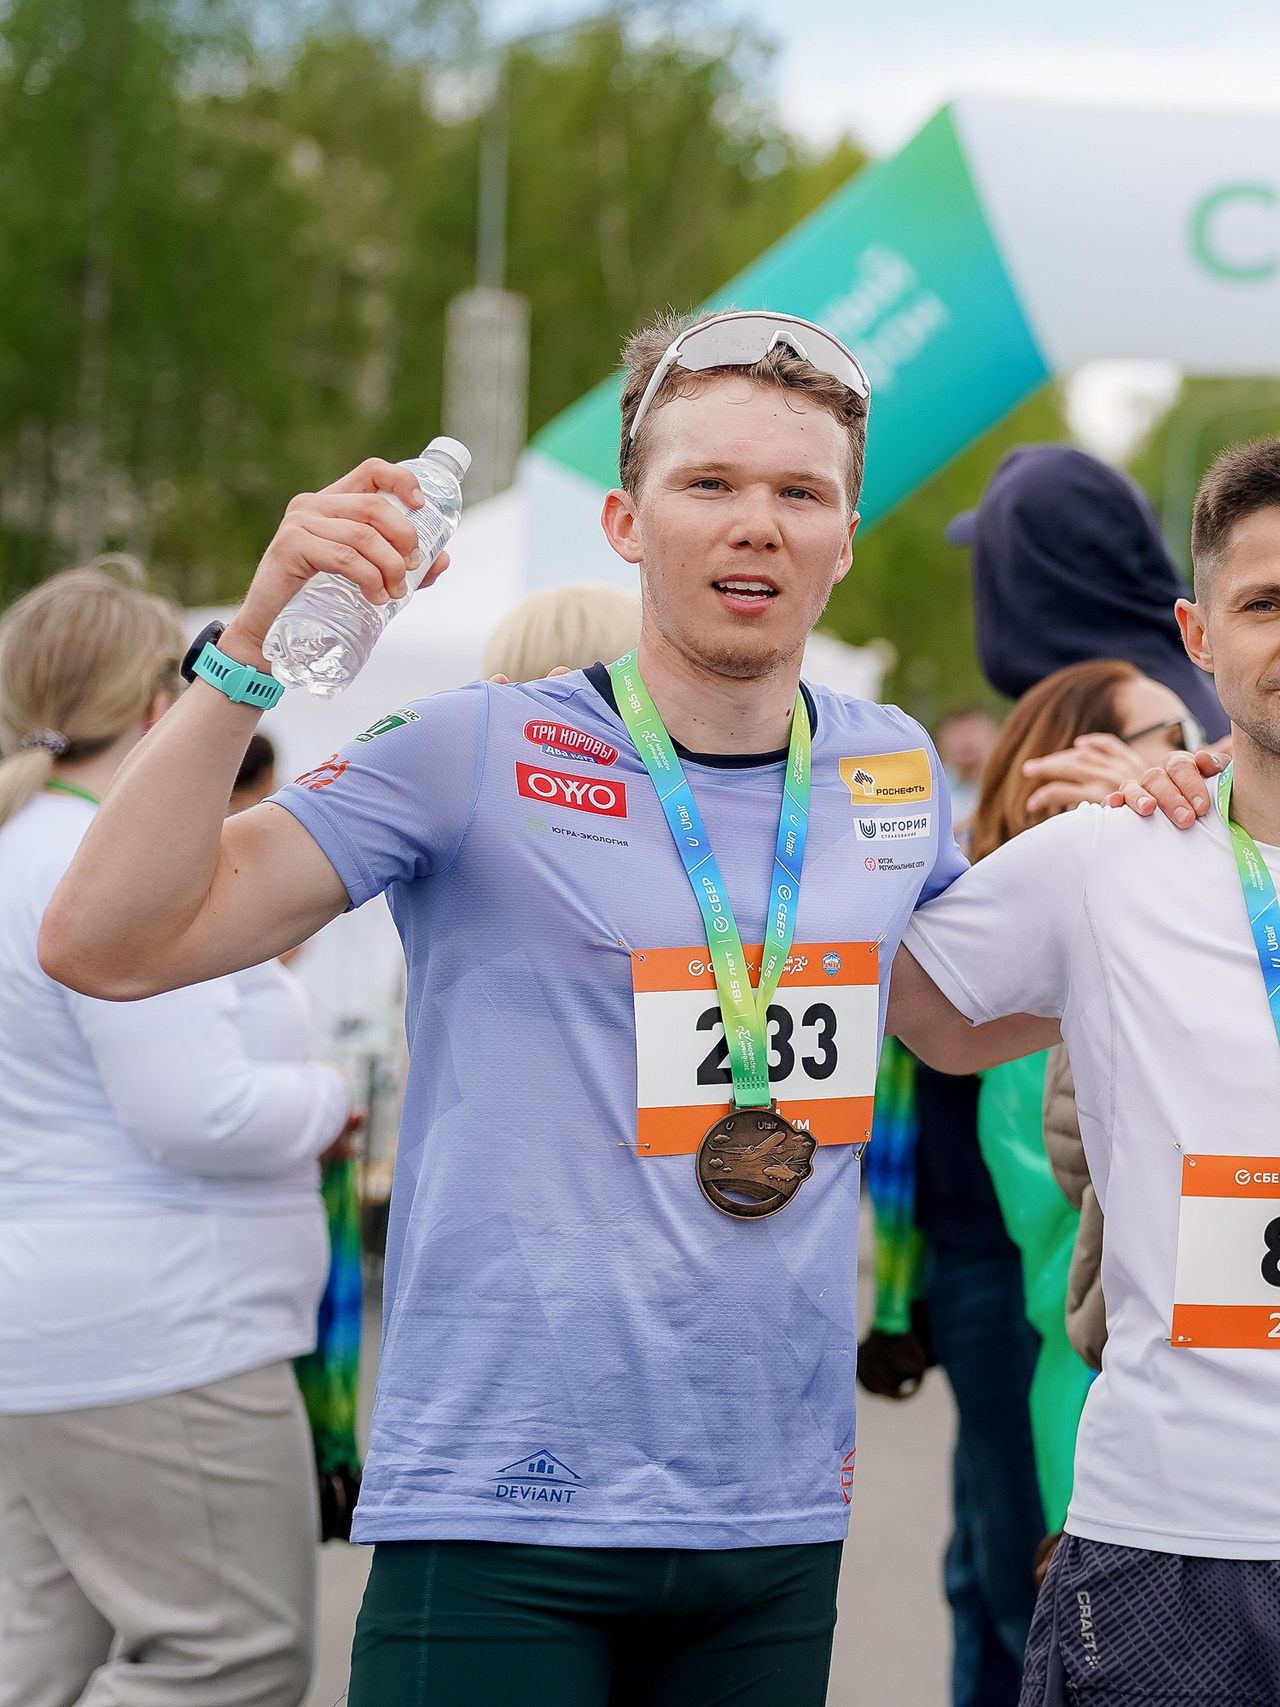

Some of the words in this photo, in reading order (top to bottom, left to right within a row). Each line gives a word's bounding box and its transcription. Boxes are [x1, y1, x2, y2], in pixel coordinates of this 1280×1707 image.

[623, 674, 634, 691] лет
[628, 693, 642, 714] 185
[532, 725, 556, 741] ТРИ
[876, 785, 925, 795] РОСНЕФТЬ
[677, 804, 692, 830] Utair
[880, 818, 927, 832] ЮГОРИЯ
[552, 827, 629, 847] ЮГРА-ЭКОЛОГИЯ
[785, 831, 797, 857] Utair
[702, 877, 722, 913] СБЕР
[776, 903, 787, 938] СБЕР
[1263, 925, 1279, 952] Utair
[725, 951, 737, 976] лет
[764, 955, 778, 979] 185
[730, 981, 743, 1005] 185
[696, 1002, 838, 1086] 233
[757, 1121, 778, 1130] Utair
[1077, 1591, 1098, 1652] CRAFT
